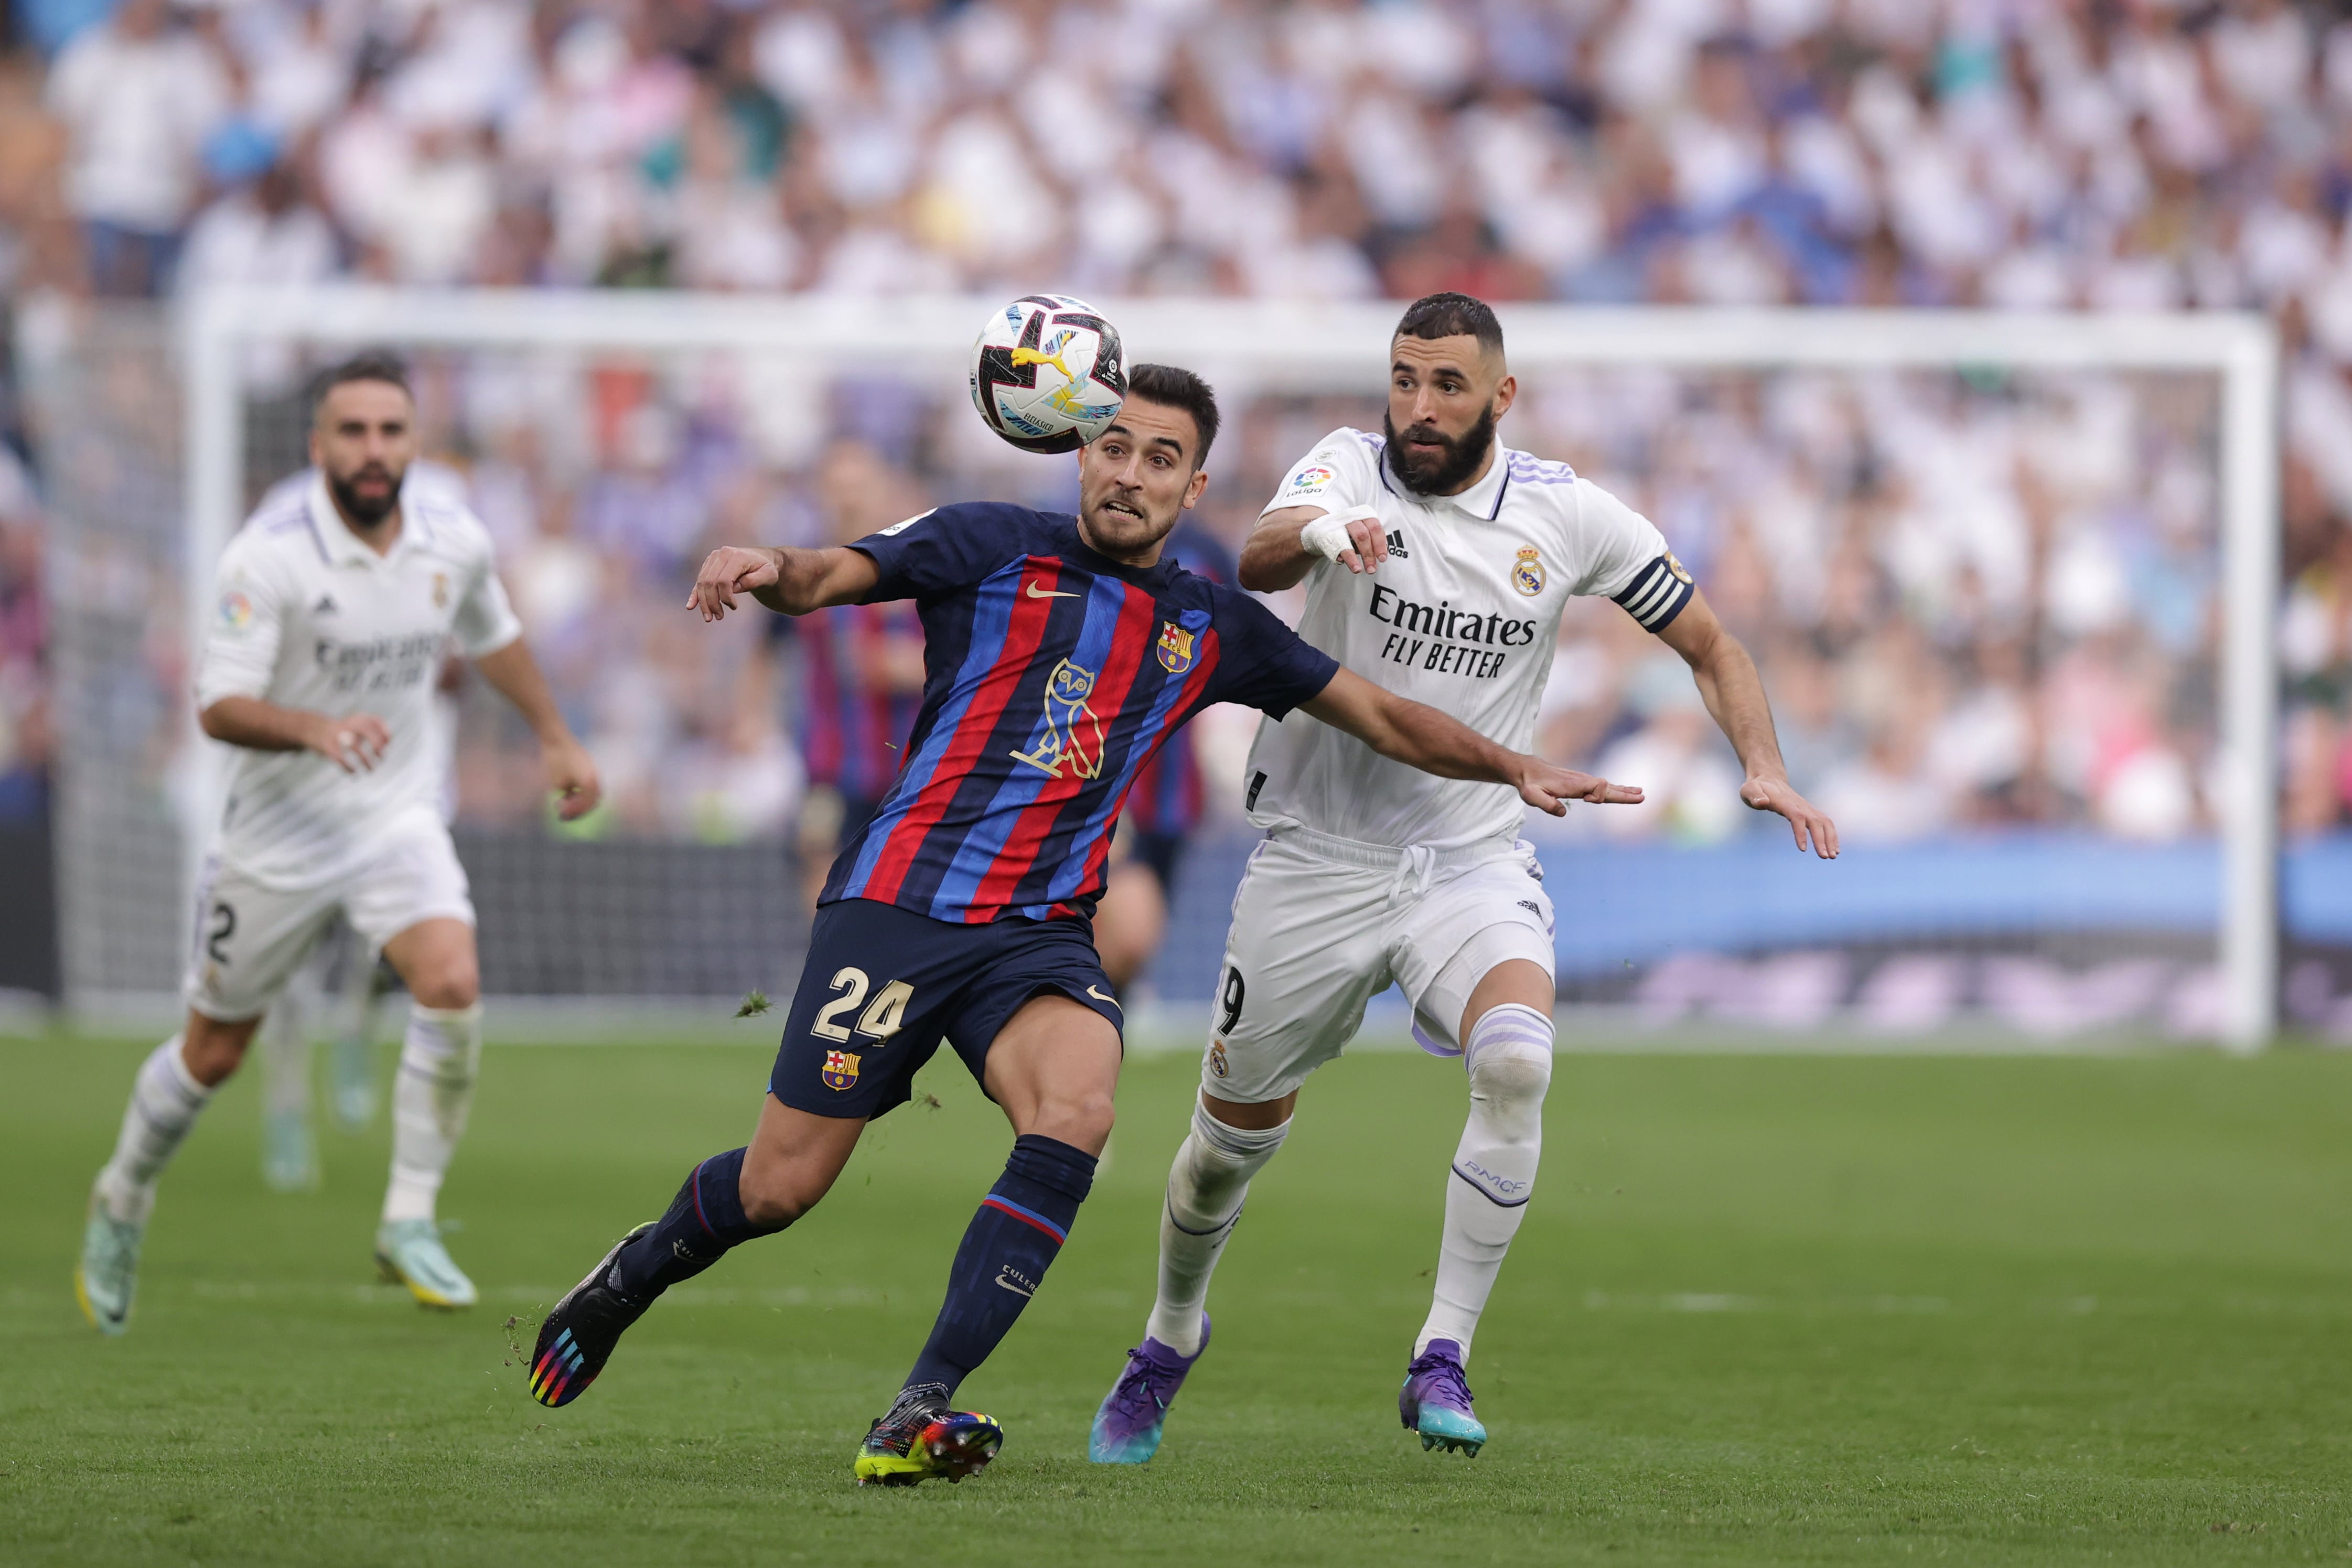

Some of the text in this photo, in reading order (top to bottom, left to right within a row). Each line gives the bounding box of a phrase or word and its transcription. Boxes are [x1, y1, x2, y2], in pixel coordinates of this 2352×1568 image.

[1286, 487, 1322, 497] LaLiga
[1370, 582, 1536, 646] Emirates
[1167, 643, 1181, 653] FCB
[1381, 633, 1506, 678] FLY BETTER
[208, 902, 237, 963] 2
[810, 966, 915, 1047] 24
[1217, 966, 1245, 1037] 9
[1465, 1160, 1527, 1193] RMCF
